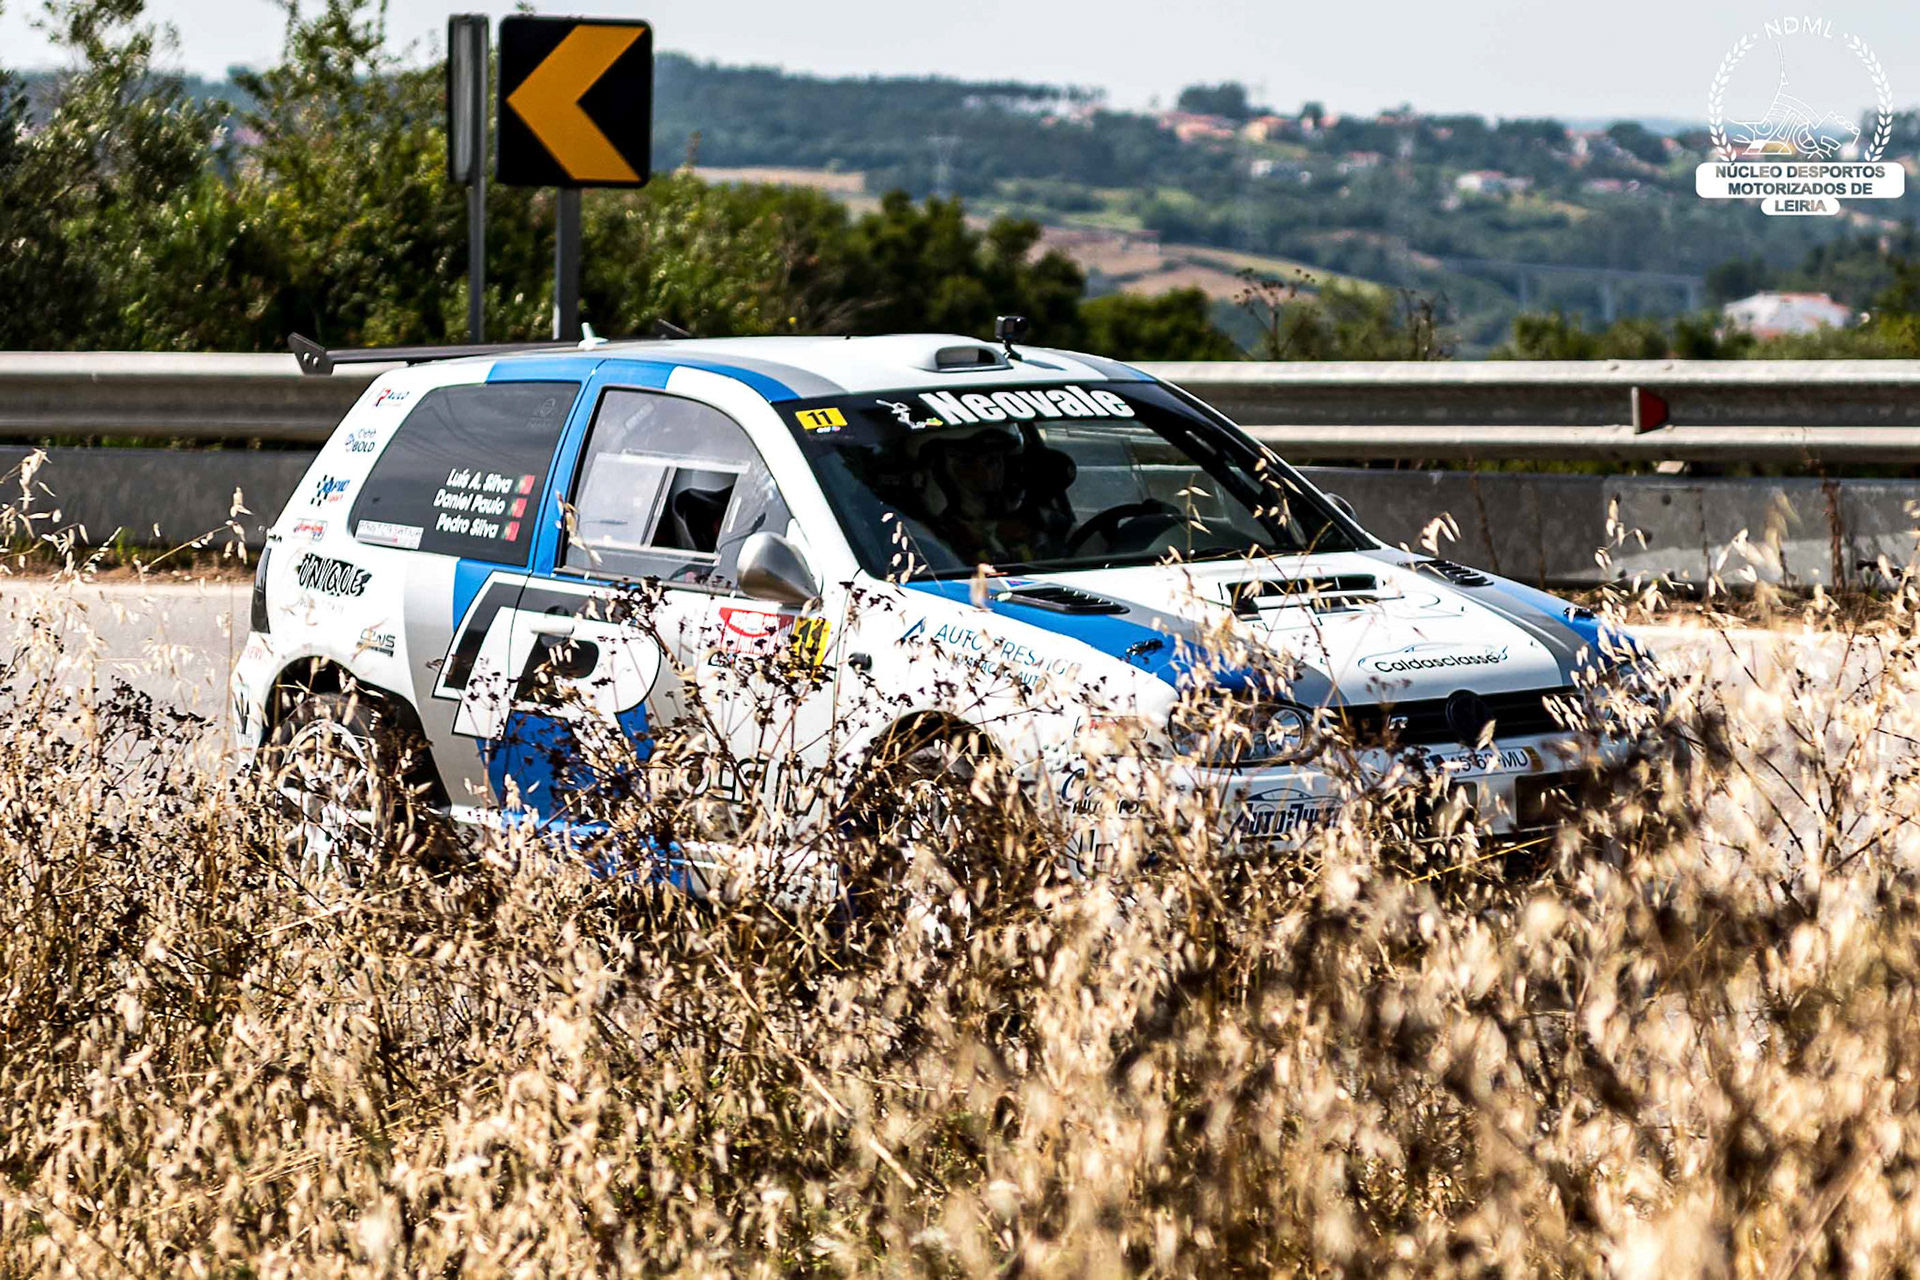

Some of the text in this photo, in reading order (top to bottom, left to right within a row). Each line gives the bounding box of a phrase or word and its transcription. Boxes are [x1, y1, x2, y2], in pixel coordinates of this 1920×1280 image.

[806, 410, 833, 426] 11
[918, 385, 1136, 426] Neovale
[446, 468, 470, 489] Luís
[482, 473, 514, 494] Silva
[433, 488, 506, 516] Daniel Paulo
[435, 512, 471, 534] Pedro
[469, 518, 500, 539] Silva
